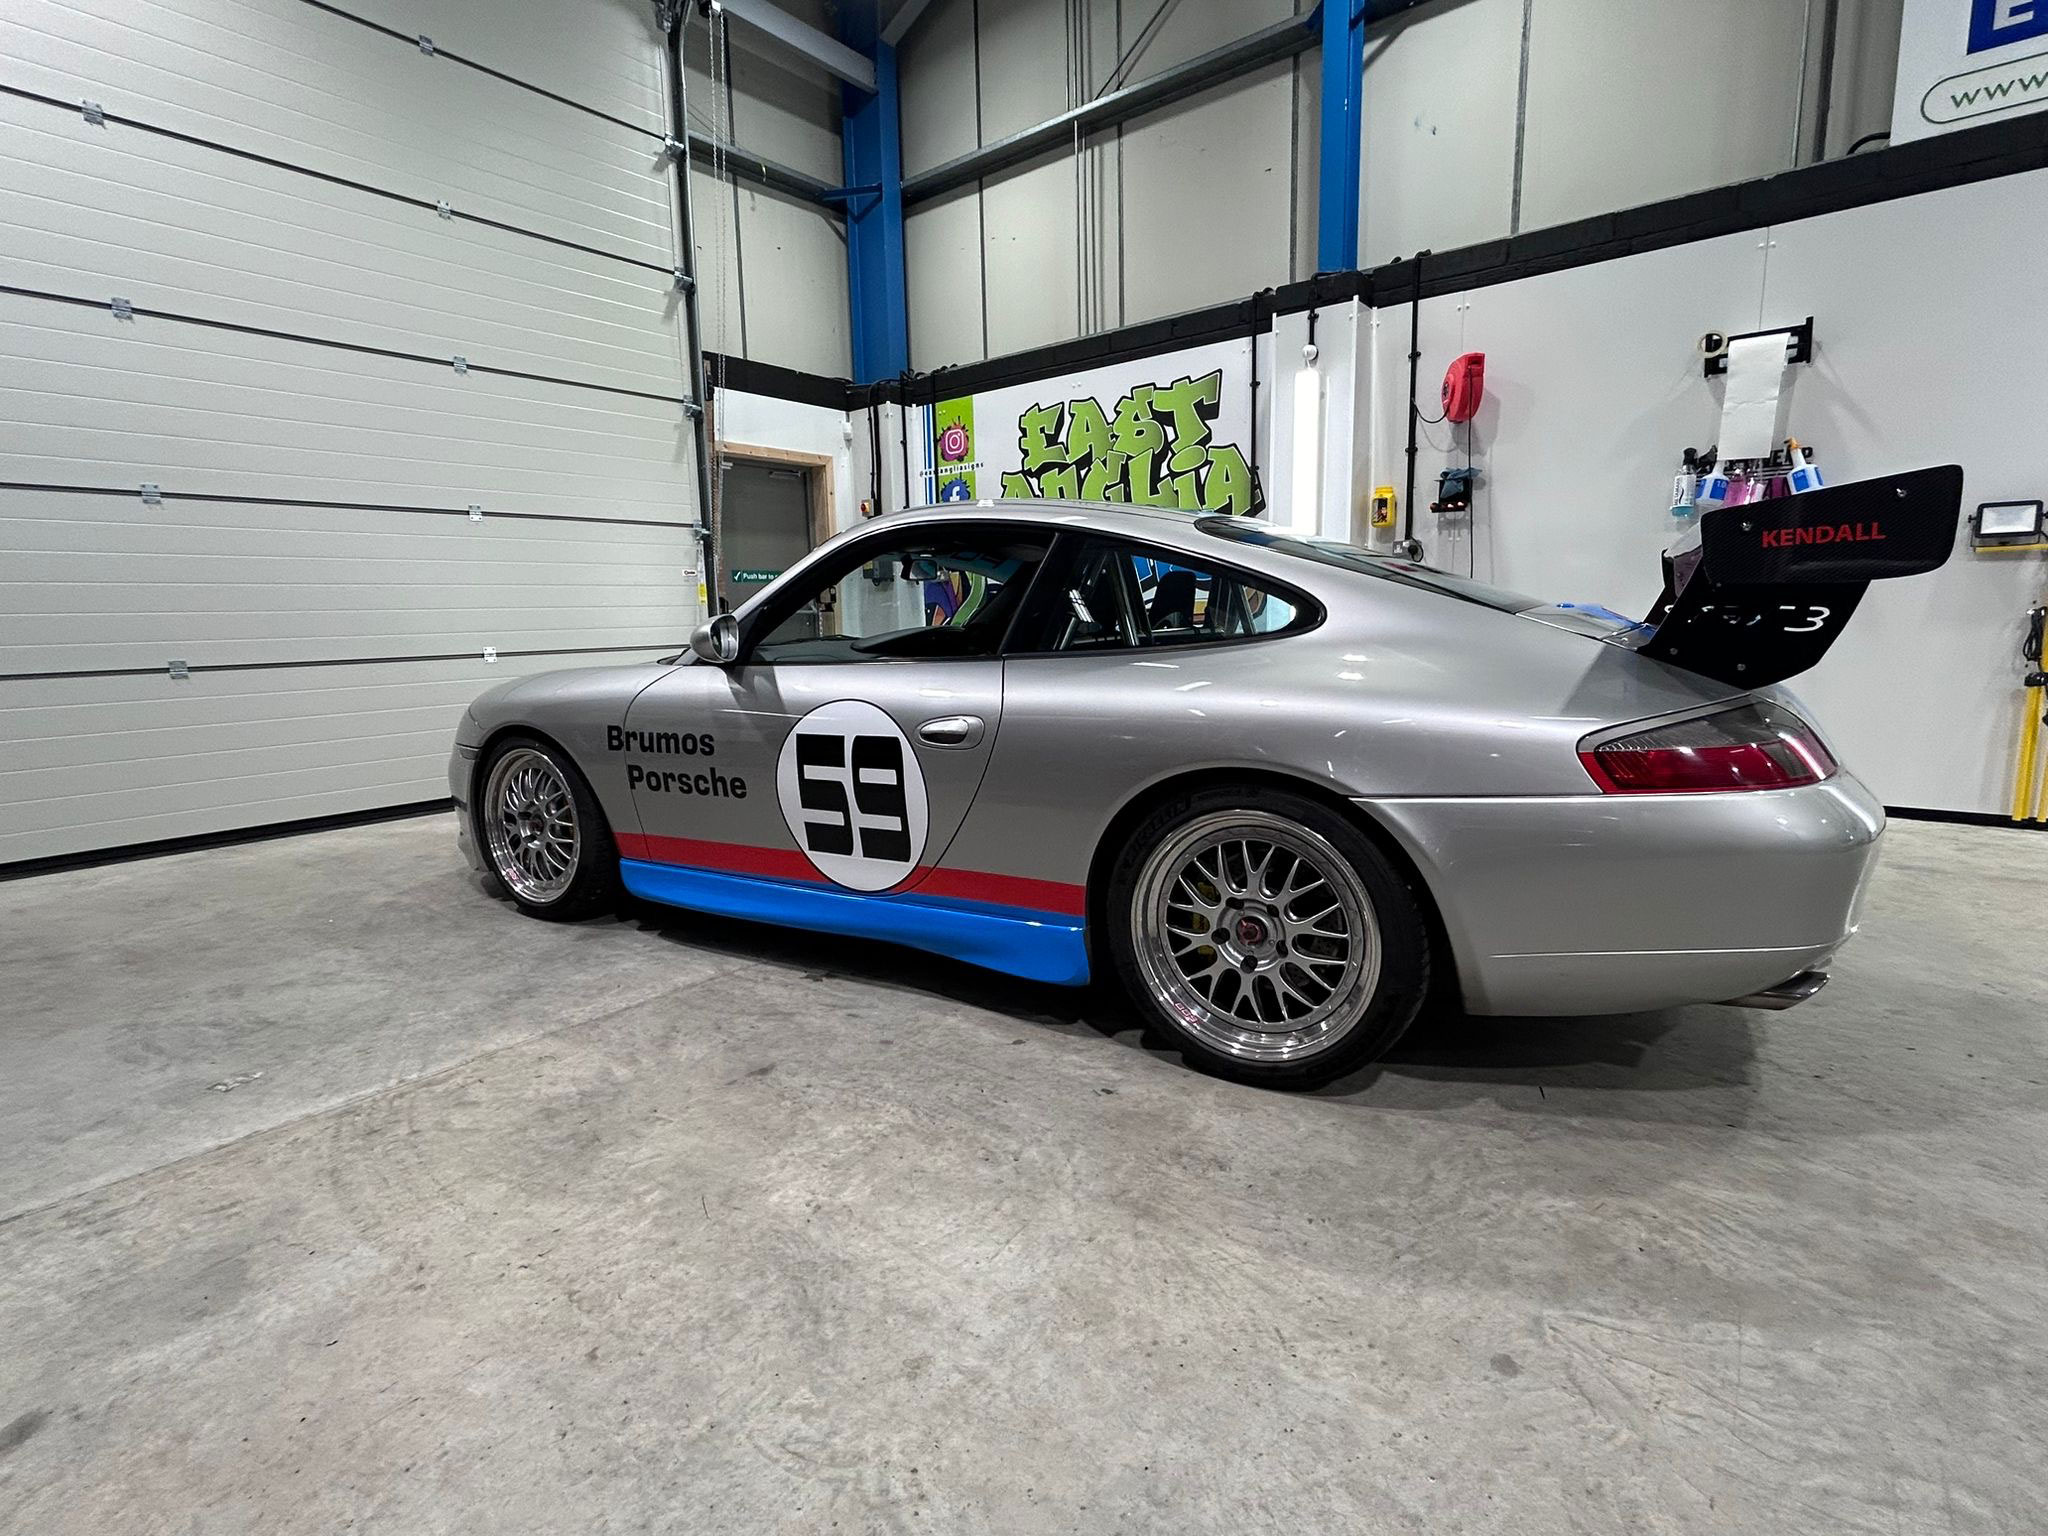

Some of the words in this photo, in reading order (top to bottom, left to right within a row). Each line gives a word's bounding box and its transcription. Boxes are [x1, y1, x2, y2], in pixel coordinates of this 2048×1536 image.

[1018, 369, 1223, 475] EAST
[1761, 522, 1887, 548] KENDALL
[743, 572, 758, 580] Push
[606, 724, 715, 757] Brumos
[627, 764, 748, 799] Porsche
[795, 732, 912, 863] 59
